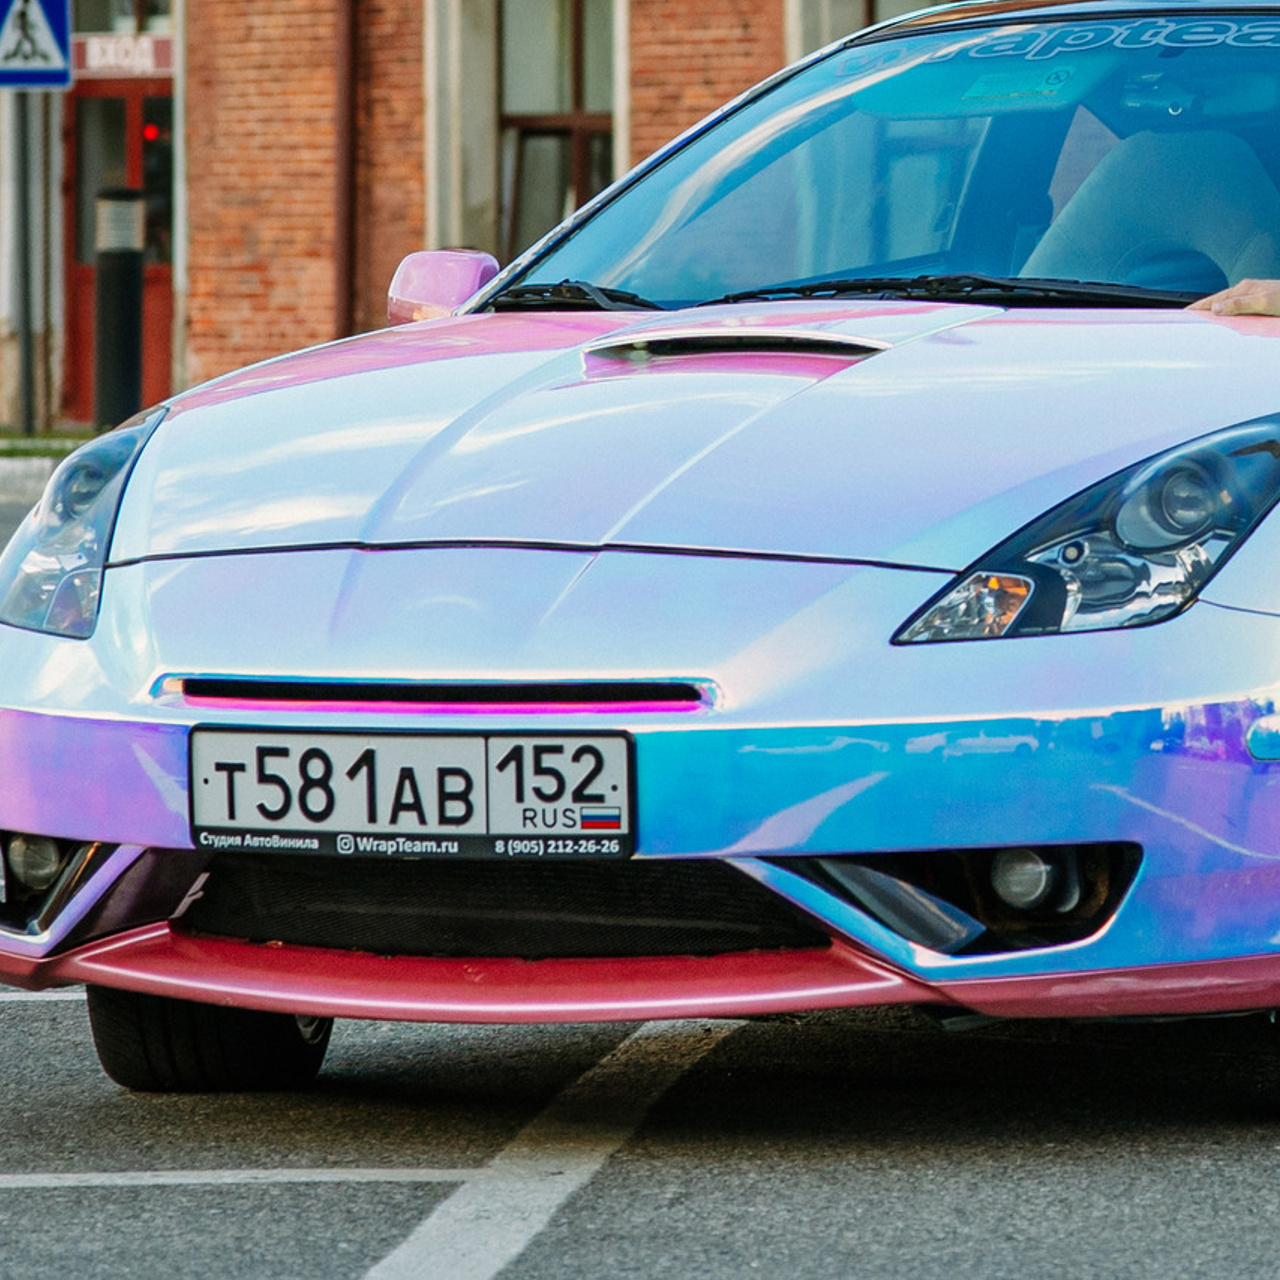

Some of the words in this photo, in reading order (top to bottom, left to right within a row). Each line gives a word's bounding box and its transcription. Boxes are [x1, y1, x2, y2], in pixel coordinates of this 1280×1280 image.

[496, 744, 606, 804] 152
[522, 807, 577, 829] RUS
[199, 831, 242, 849] Студия
[356, 836, 459, 855] WrapTeam.ru
[494, 839, 506, 853] 8
[507, 839, 545, 856] (905)
[547, 840, 620, 854] 212-26-26
